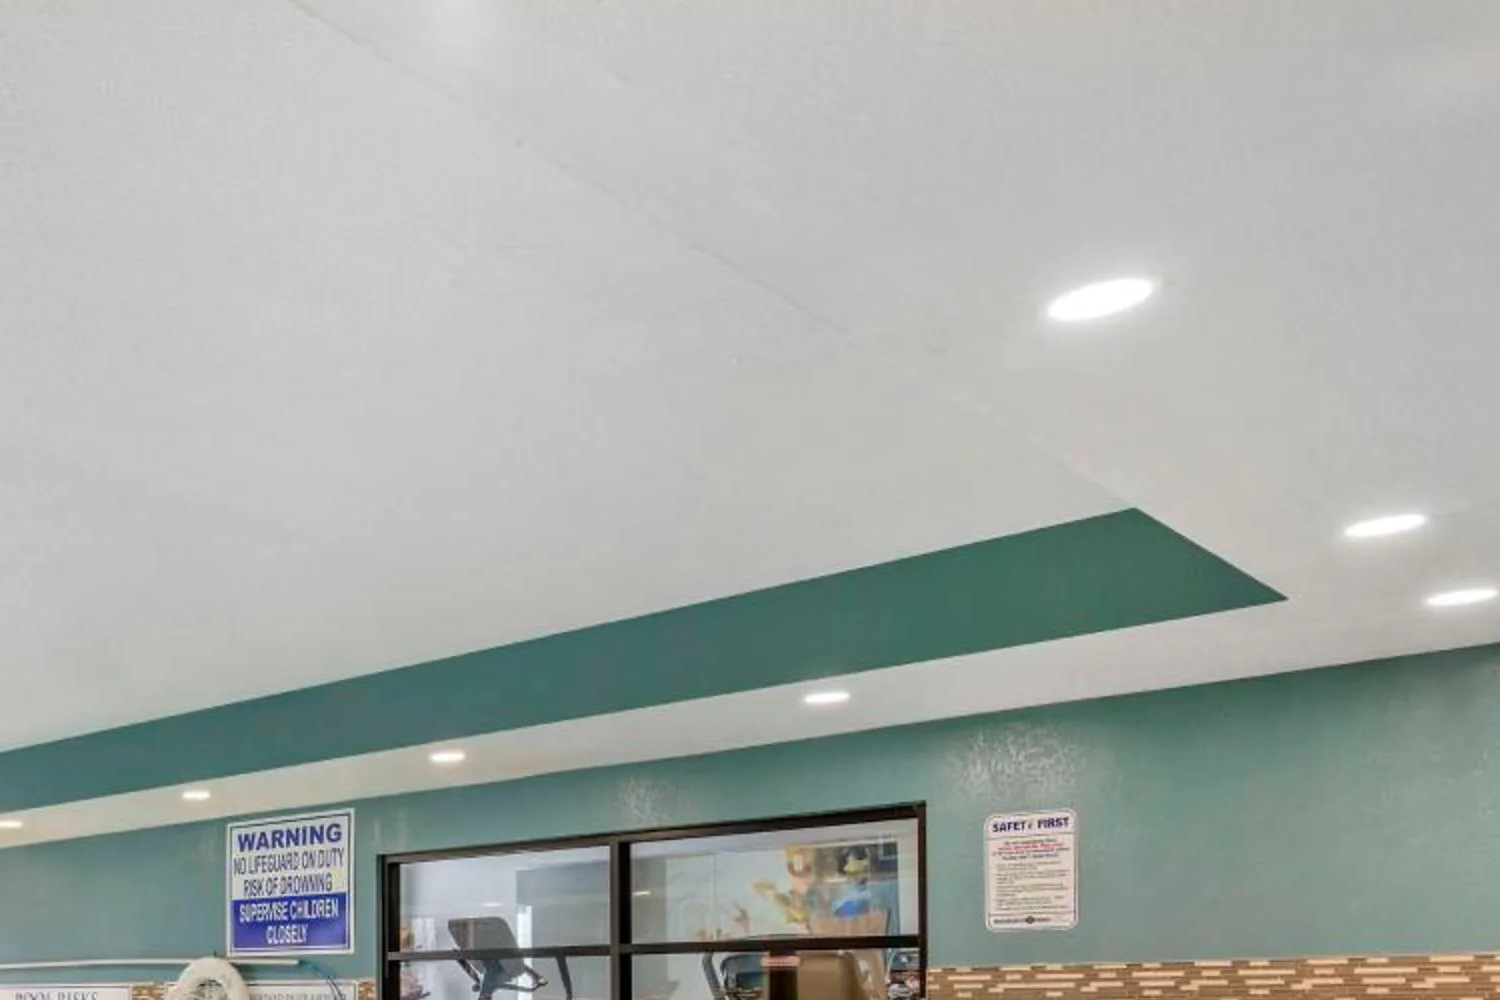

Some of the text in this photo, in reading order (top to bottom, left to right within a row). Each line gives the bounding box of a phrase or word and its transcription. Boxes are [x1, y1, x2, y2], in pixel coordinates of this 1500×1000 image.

[1037, 816, 1069, 829] FIRST
[237, 823, 342, 853] WARNING
[234, 847, 344, 875] NO LIFEGUARD ON DUTY
[244, 872, 332, 898] RISK OF DROWNING
[240, 898, 339, 923] SUPERVISE CHILDREN
[266, 924, 308, 945] CLOSELY
